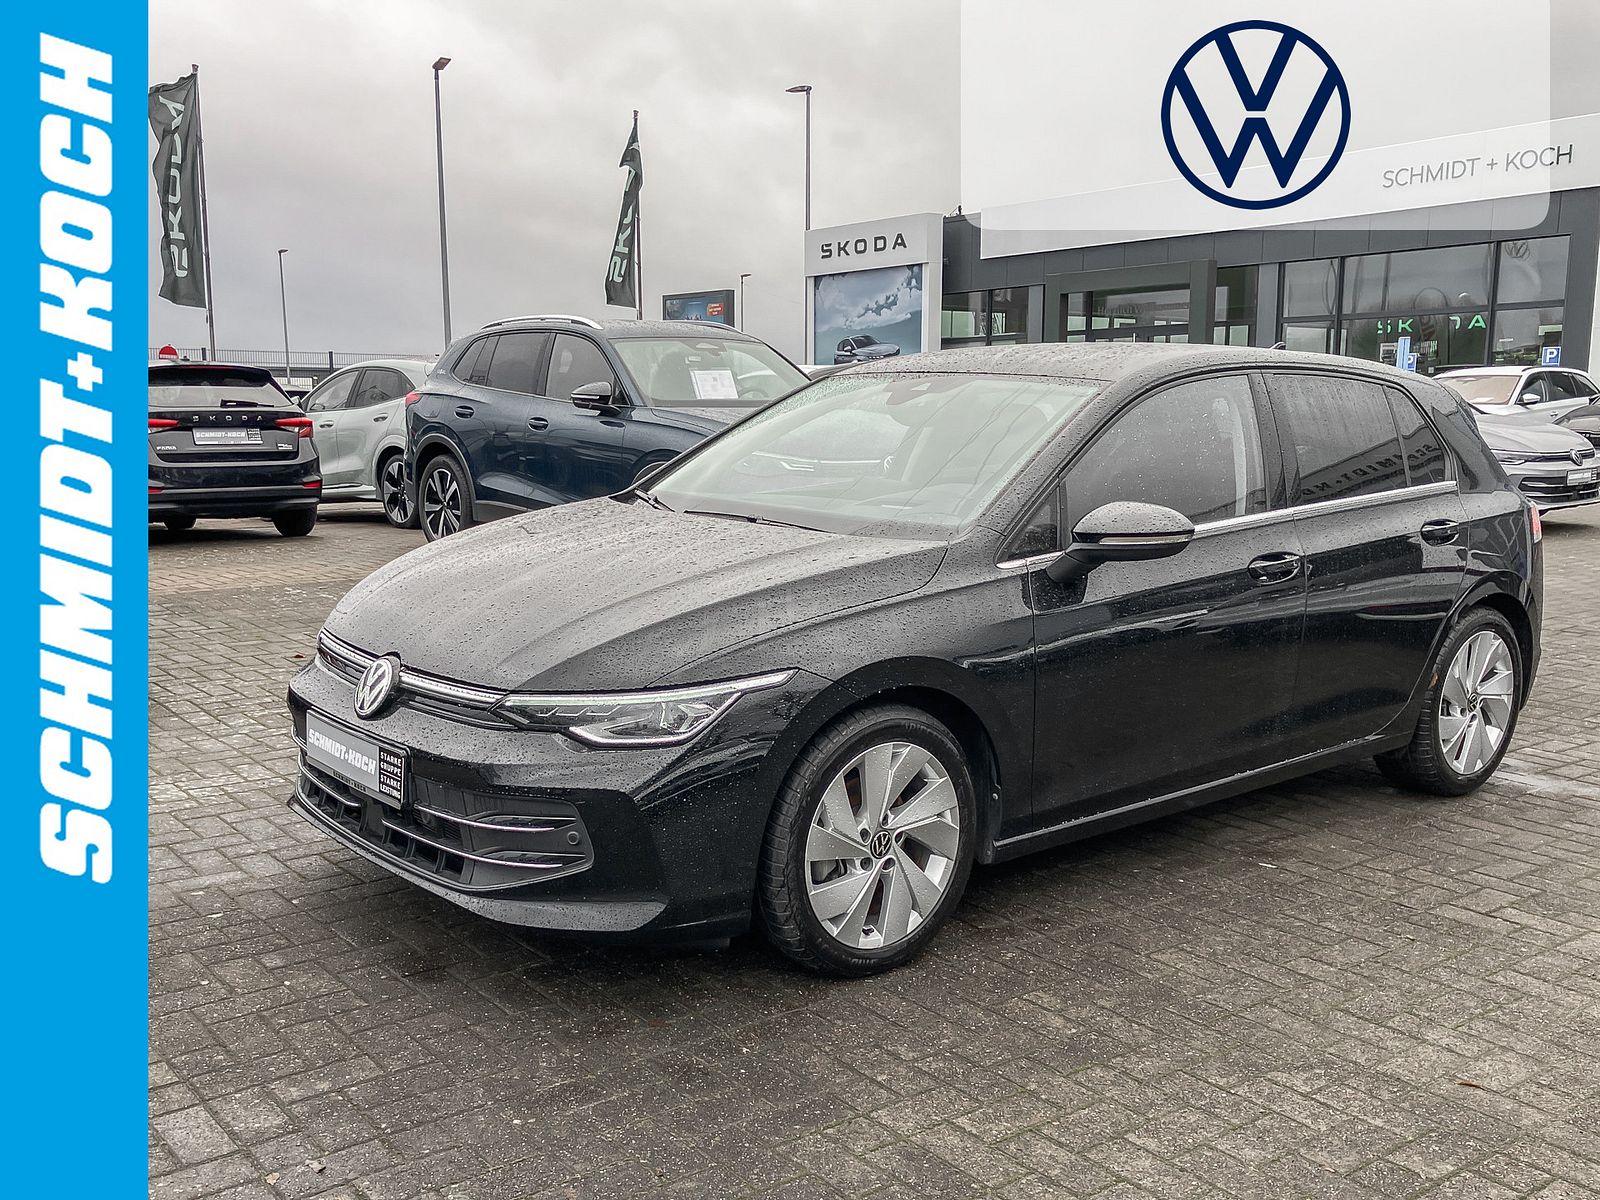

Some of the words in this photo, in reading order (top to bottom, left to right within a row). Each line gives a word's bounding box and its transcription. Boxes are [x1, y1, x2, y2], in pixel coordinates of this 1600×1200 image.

[1382, 157, 1481, 189] SCHMIDT
[1505, 144, 1573, 172] KOCH
[820, 232, 907, 259] SKODA
[1377, 314, 1487, 334] SKDA
[1546, 348, 1557, 363] P
[380, 751, 402, 767] STARKE
[380, 774, 401, 790] STARKE
